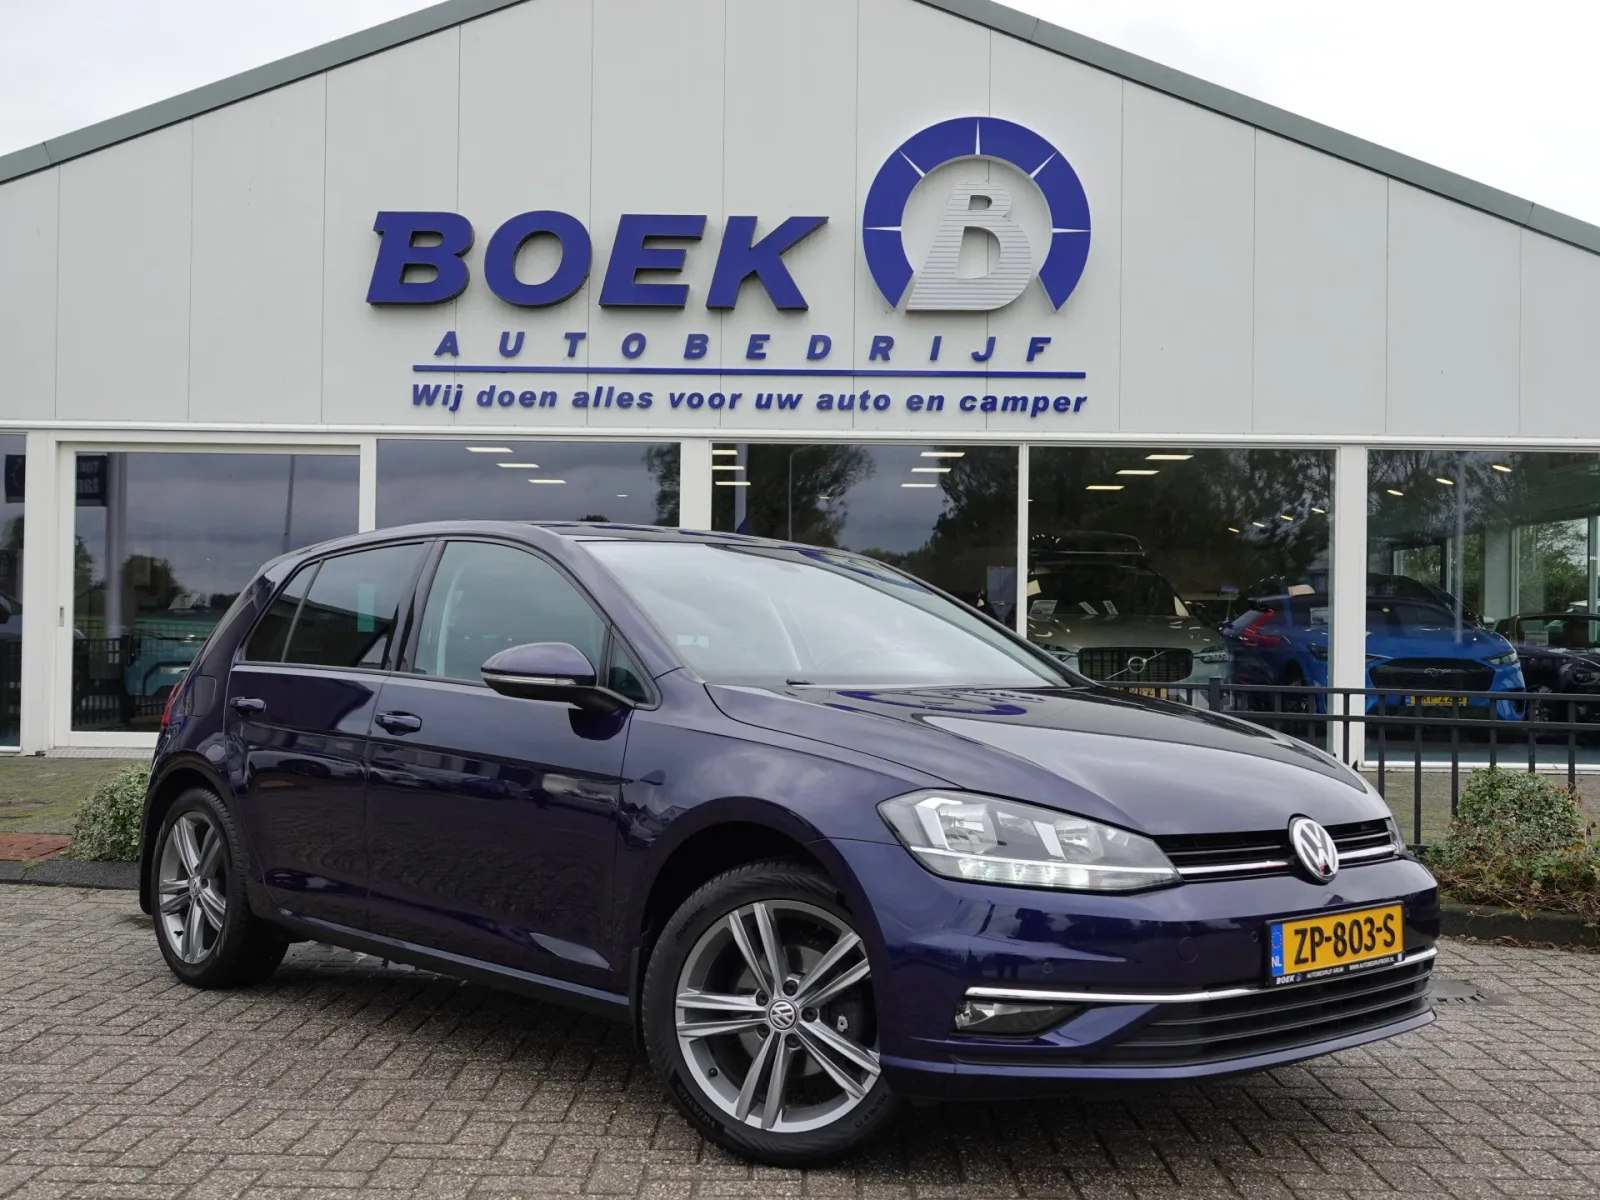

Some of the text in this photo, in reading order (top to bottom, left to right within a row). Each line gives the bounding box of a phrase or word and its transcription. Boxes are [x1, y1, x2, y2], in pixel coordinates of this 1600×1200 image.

[366, 210, 828, 311] BOEK
[434, 331, 1051, 362] AUTOBEDRIJF
[412, 384, 1088, 417] Wij doen alles voor uw auto en camper
[1293, 912, 1396, 966] ZP-803-S
[1271, 956, 1283, 968] NL
[1276, 974, 1295, 985] BOEK
